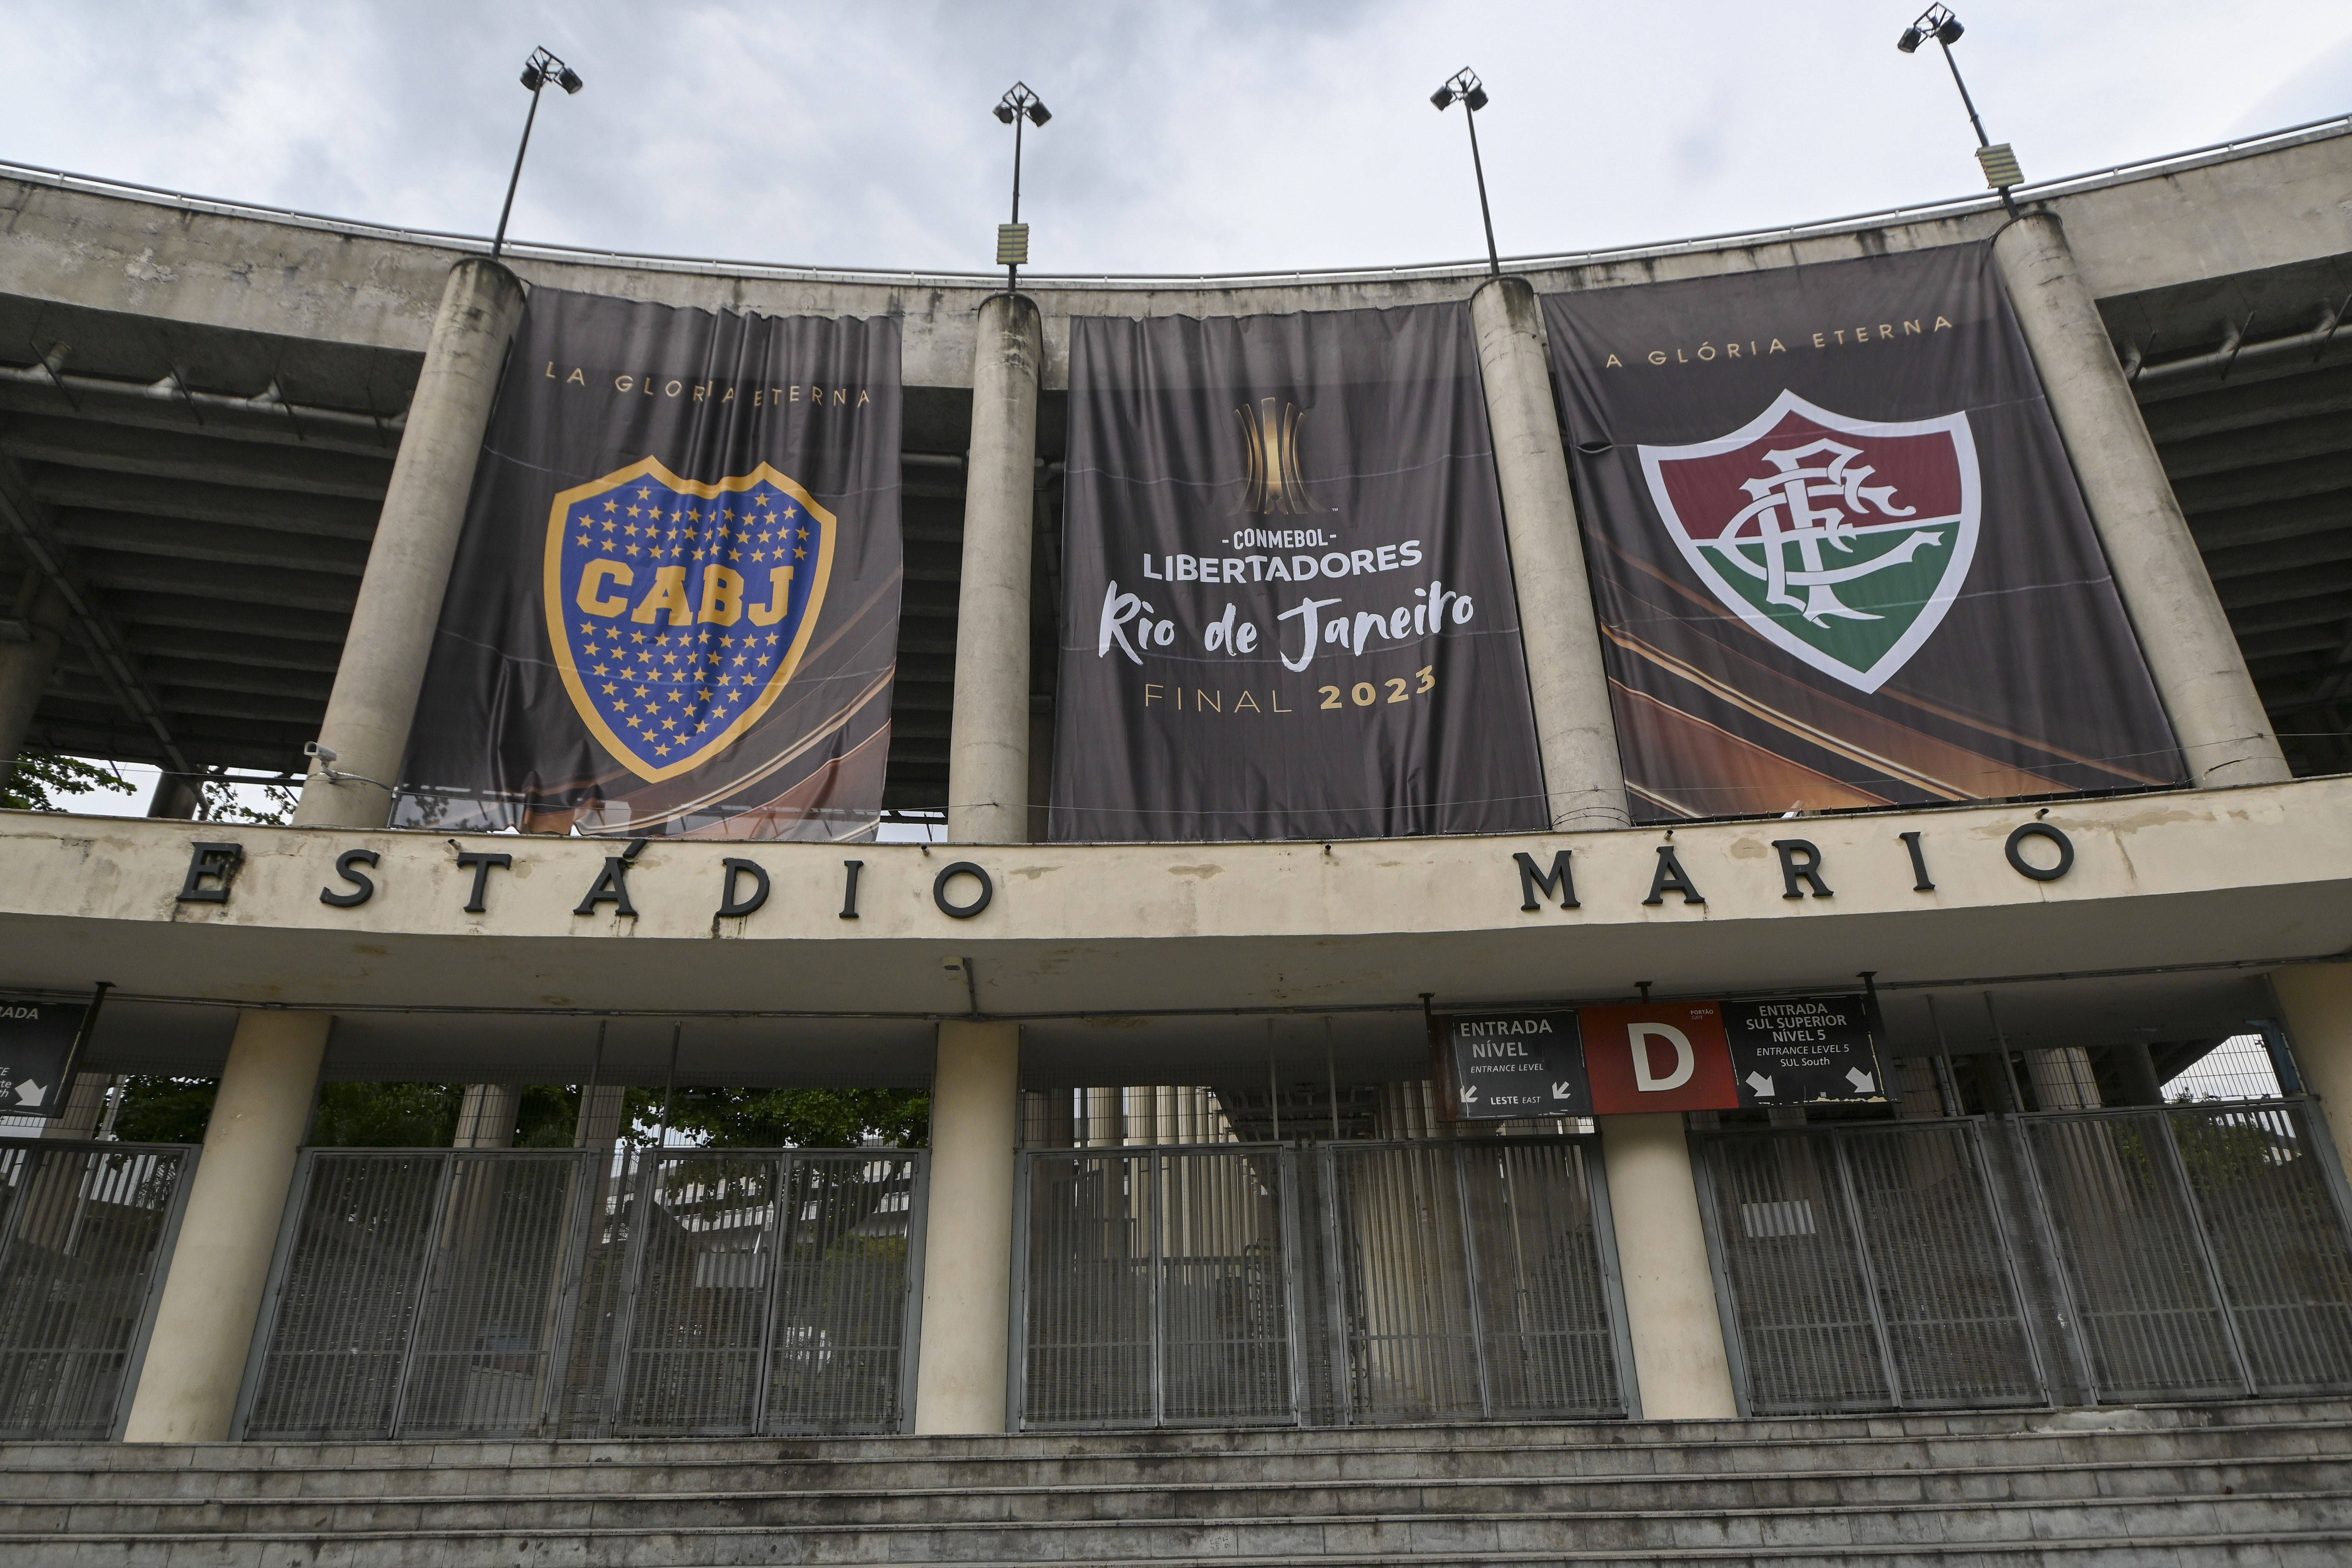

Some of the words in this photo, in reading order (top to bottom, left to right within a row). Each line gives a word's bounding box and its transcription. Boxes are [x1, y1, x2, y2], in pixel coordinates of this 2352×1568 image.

[1606, 354, 1623, 368] A
[1648, 338, 1786, 366] GLÓRIA
[1813, 316, 1953, 348] ETERNA
[545, 361, 585, 386] LA
[615, 374, 735, 403] GLORIA
[753, 385, 870, 408] ETERNA
[1143, 539, 1423, 583] LIBERTADORES
[576, 558, 794, 627] CABJ
[1098, 580, 1175, 666] Rio
[1204, 602, 1258, 656] de
[1277, 580, 1474, 672] Janeiro
[1145, 683, 1292, 713] FINAL
[1318, 664, 1436, 710] 2023
[176, 838, 993, 919] ESTÁDIO
[1512, 822, 2074, 911] MARIO
[1759, 1003, 1828, 1016] ENTRADA
[1460, 1019, 1553, 1037] ENTRADA
[1746, 1018, 1774, 1030] SUL
[1776, 1015, 1847, 1029] SUPERIOR
[1772, 1028, 1815, 1043] NÍVEL
[1817, 1029, 1826, 1041] 5
[1472, 1040, 1528, 1058] NÍVEL
[1627, 1022, 1695, 1092] D
[1756, 1046, 1809, 1056] ENTRANCE
[1812, 1044, 1841, 1054] LEVEL
[1843, 1044, 1850, 1052] 5
[1470, 1064, 1516, 1073] ENTRANCE
[1519, 1063, 1544, 1071] LEVEL
[1780, 1058, 1799, 1067] SUL
[1802, 1056, 1830, 1066] South
[1490, 1096, 1519, 1105] LESTE
[1522, 1096, 1541, 1104] EAST
